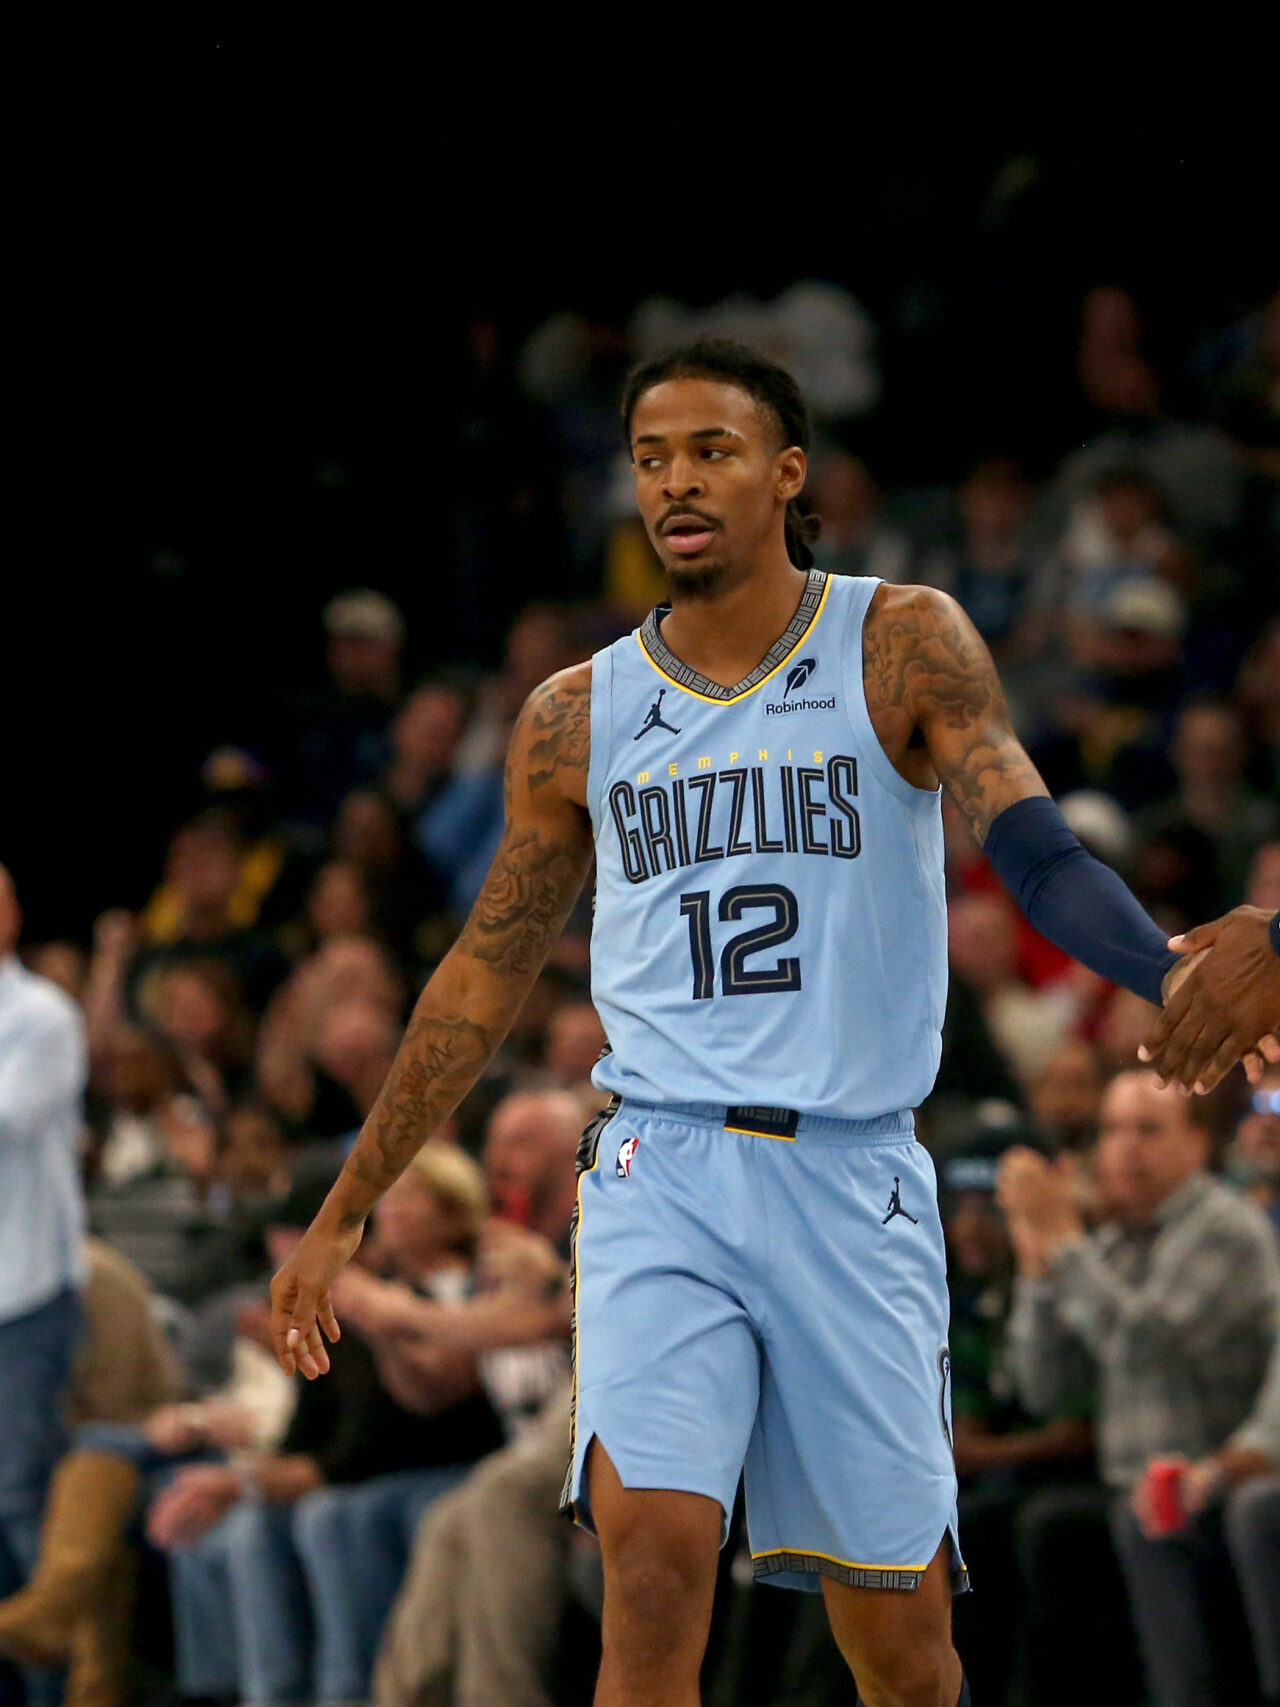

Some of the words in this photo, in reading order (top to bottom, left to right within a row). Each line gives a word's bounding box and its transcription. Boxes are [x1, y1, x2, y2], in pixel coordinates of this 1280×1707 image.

[765, 697, 836, 715] Robinhood
[608, 755, 861, 884] GRIZZLIES
[680, 883, 802, 1000] 12
